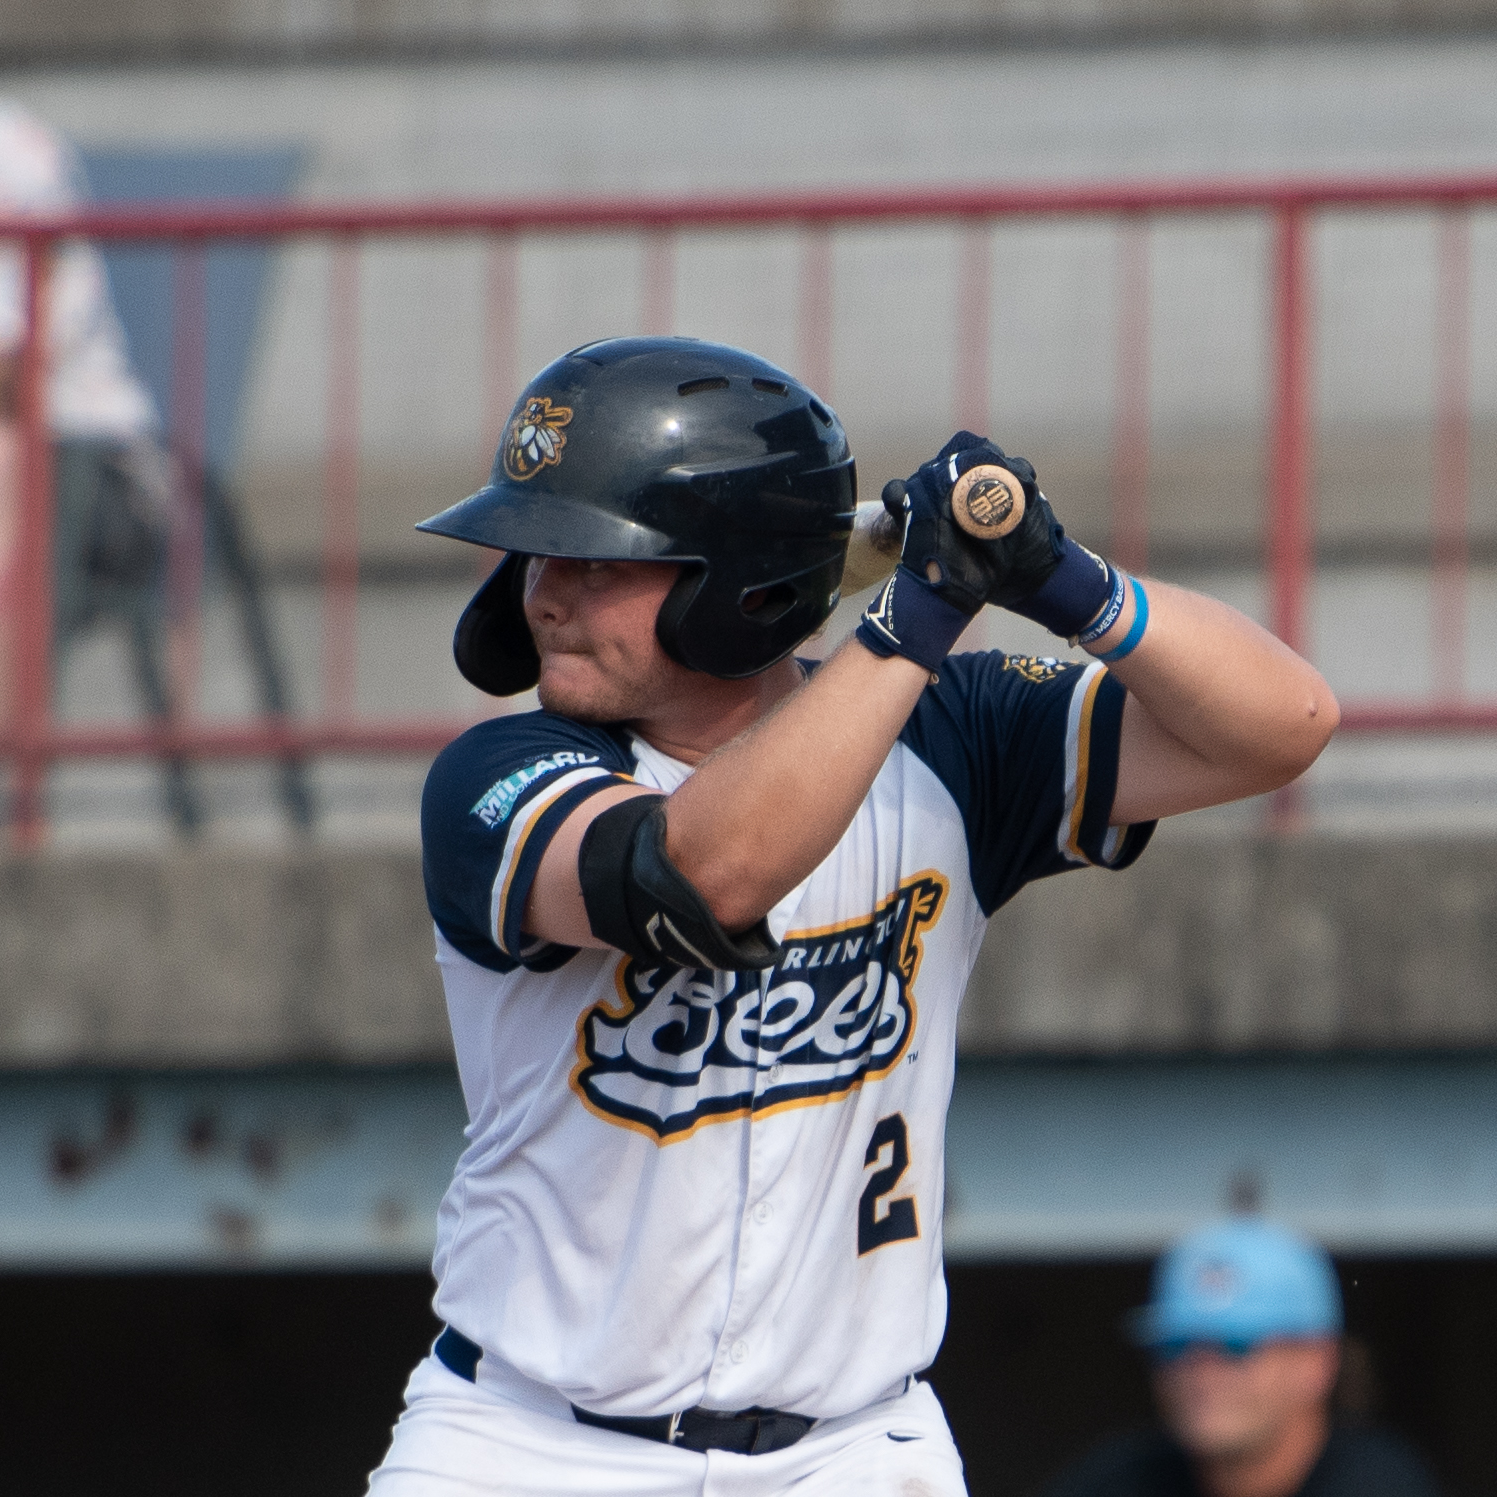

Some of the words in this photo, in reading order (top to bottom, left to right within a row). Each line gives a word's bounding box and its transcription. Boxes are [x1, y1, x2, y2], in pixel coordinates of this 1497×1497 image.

[970, 484, 1010, 517] 33
[1095, 603, 1120, 634] MERCY
[593, 958, 907, 1074] Bees
[857, 1111, 922, 1258] 2
